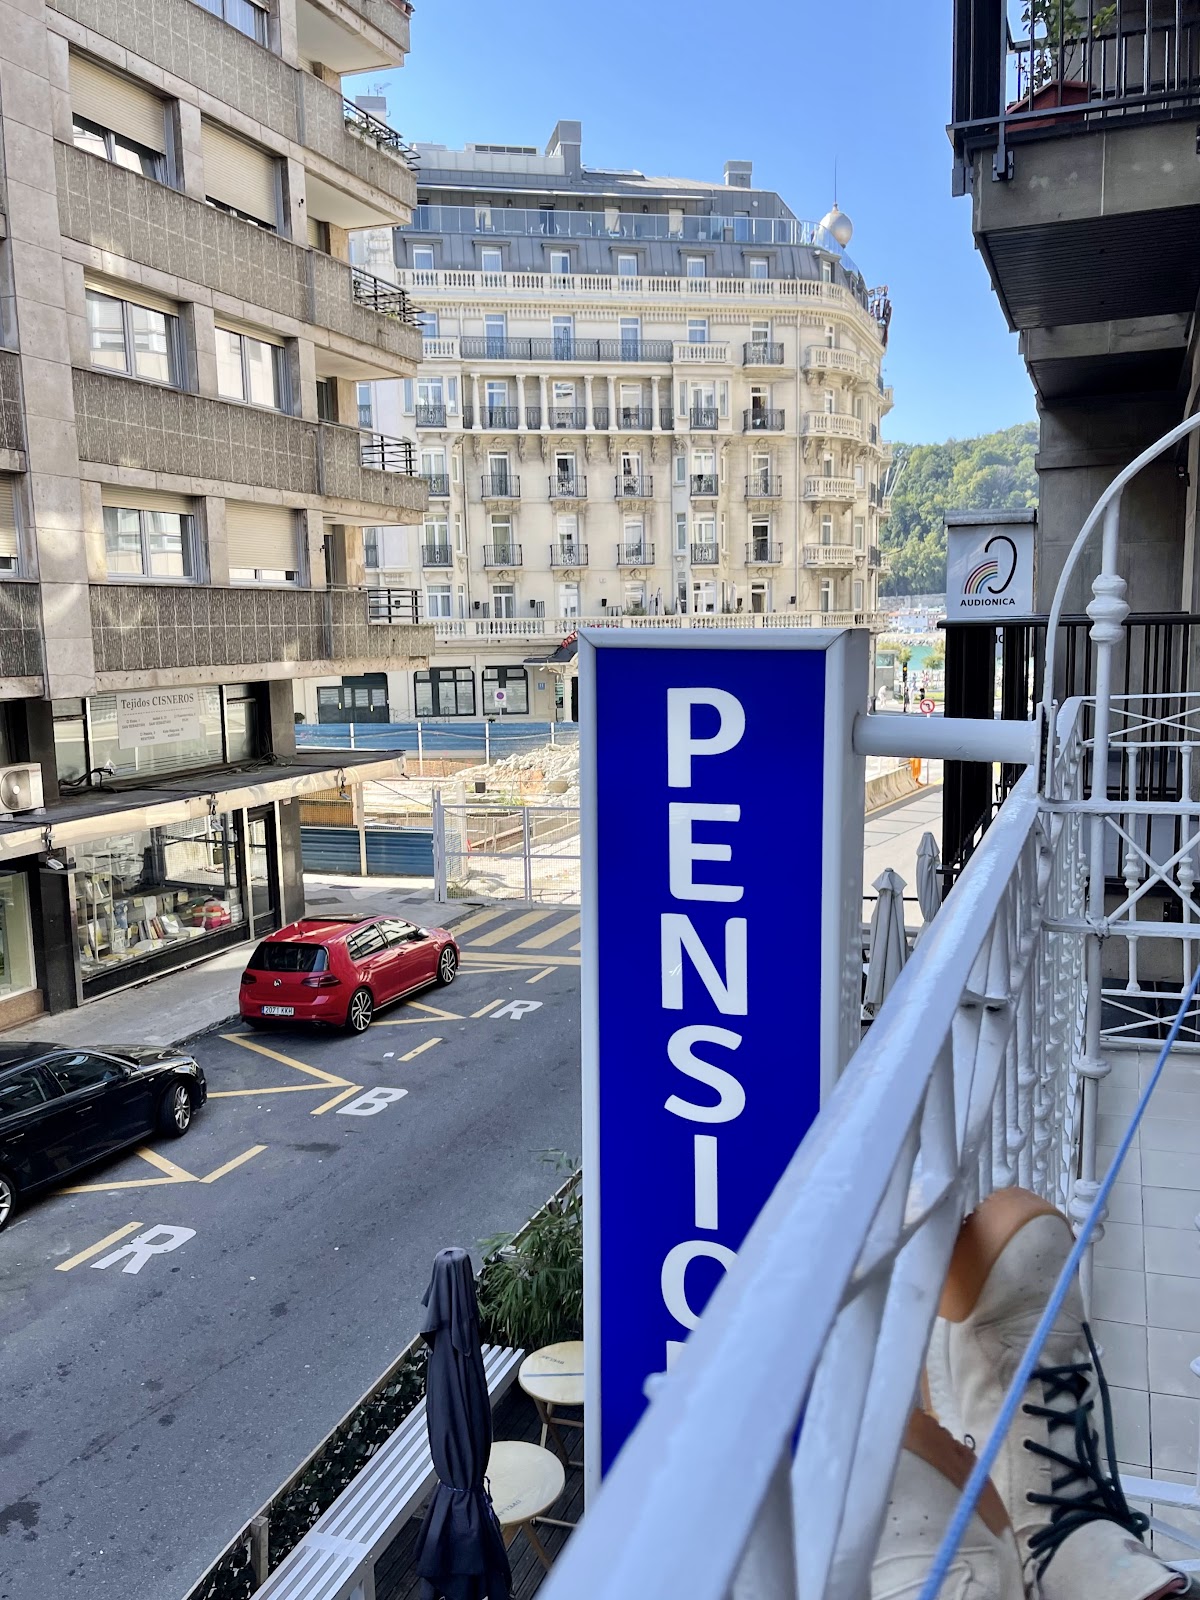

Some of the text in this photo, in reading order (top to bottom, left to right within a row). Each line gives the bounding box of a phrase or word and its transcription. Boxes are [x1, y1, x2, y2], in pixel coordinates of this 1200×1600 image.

[960, 598, 1016, 607] AUDIONICA
[121, 693, 194, 710] Tejidos CISNEROS
[265, 1006, 280, 1014] 2071
[489, 999, 544, 1020] R
[660, 687, 748, 1372] PENSIO
[335, 1087, 409, 1117] B
[90, 1224, 197, 1275] R
